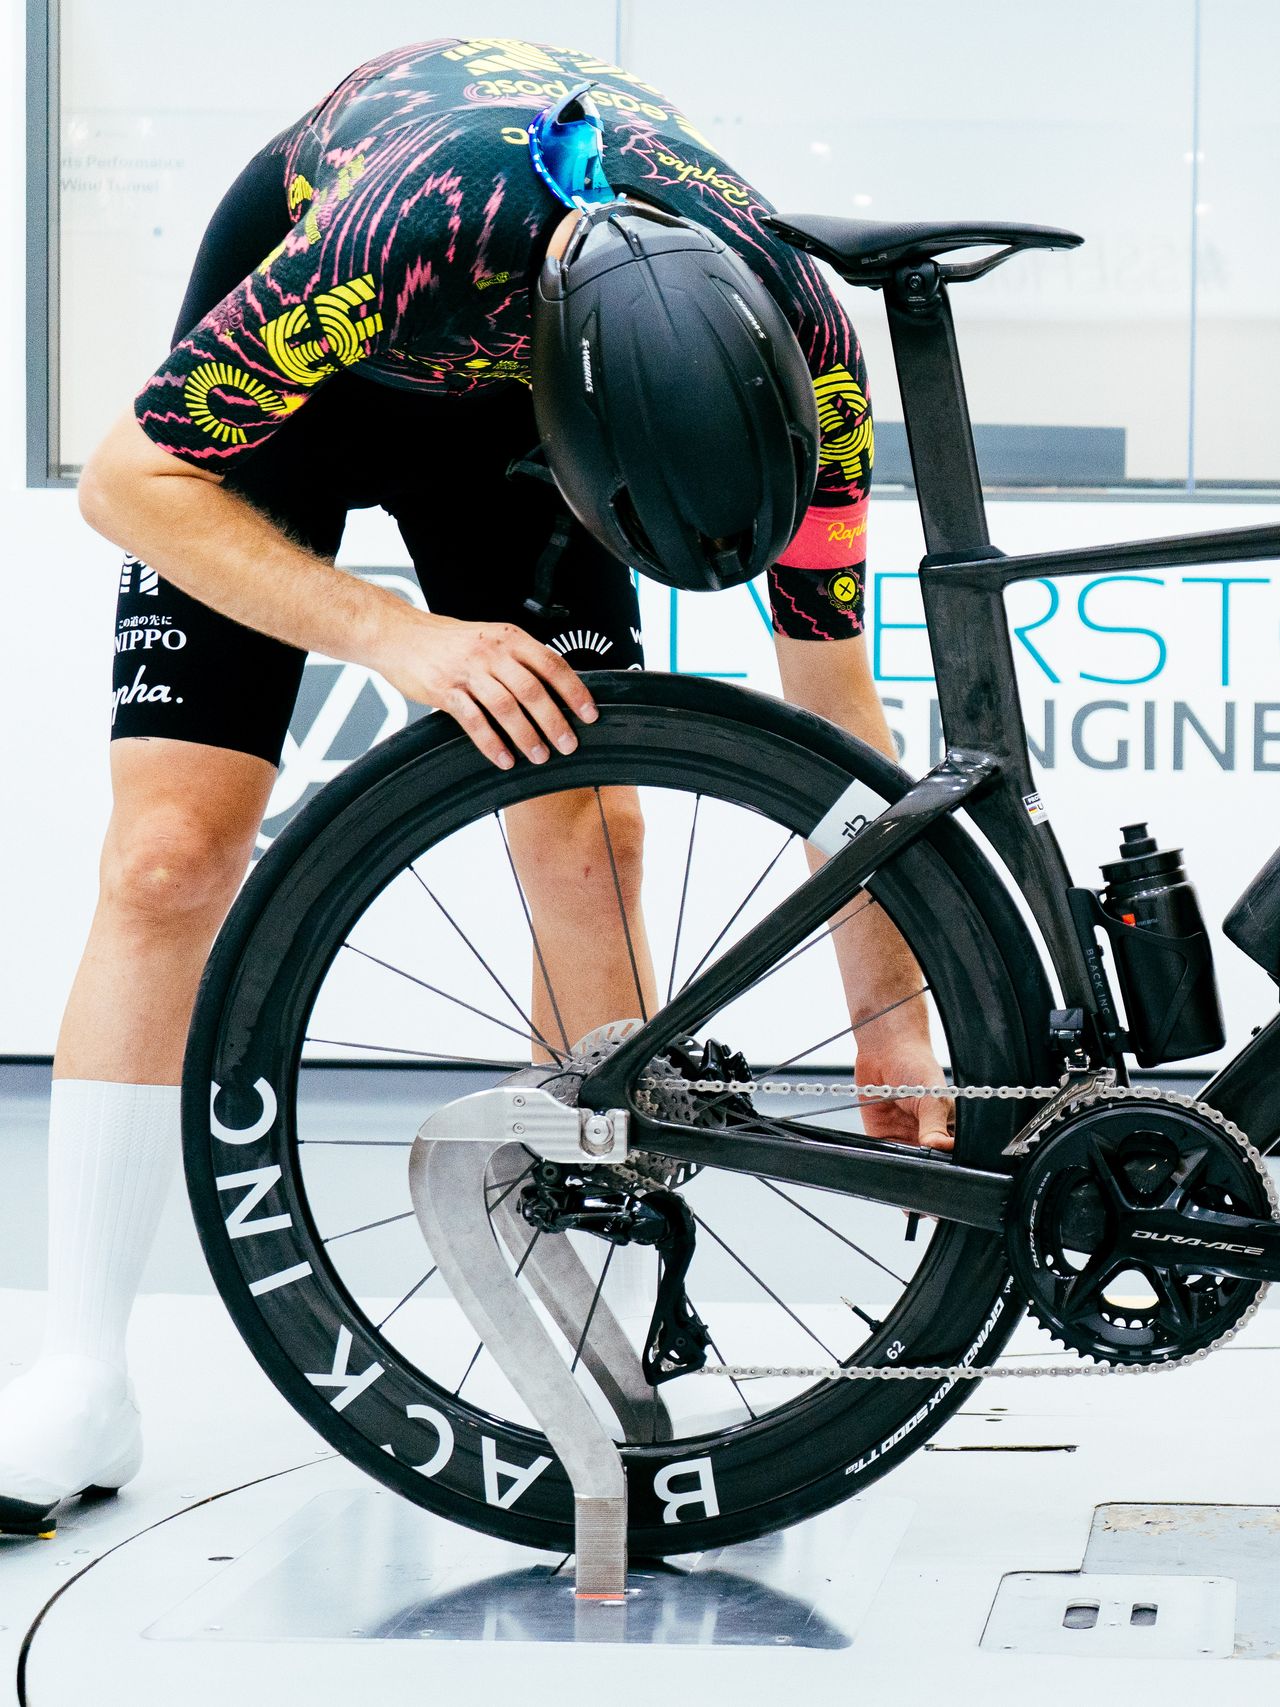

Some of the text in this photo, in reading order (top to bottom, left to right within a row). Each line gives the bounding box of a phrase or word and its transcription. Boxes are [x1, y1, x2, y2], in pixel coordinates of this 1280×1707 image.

[480, 79, 668, 121] easpost
[651, 149, 749, 205] Rapha.
[580, 337, 595, 394] S-WORKS
[119, 614, 173, 629] この道の先に
[111, 664, 184, 726] pha.
[1086, 948, 1111, 1015] BLACK INC
[1029, 1199, 1040, 1269] DURA-ACE
[1131, 1229, 1265, 1256] DURA-ACE
[209, 1077, 720, 1524] BACK INC
[886, 1340, 906, 1360] 62
[964, 1296, 1005, 1368] GRAND
[879, 1403, 930, 1454] 5000
